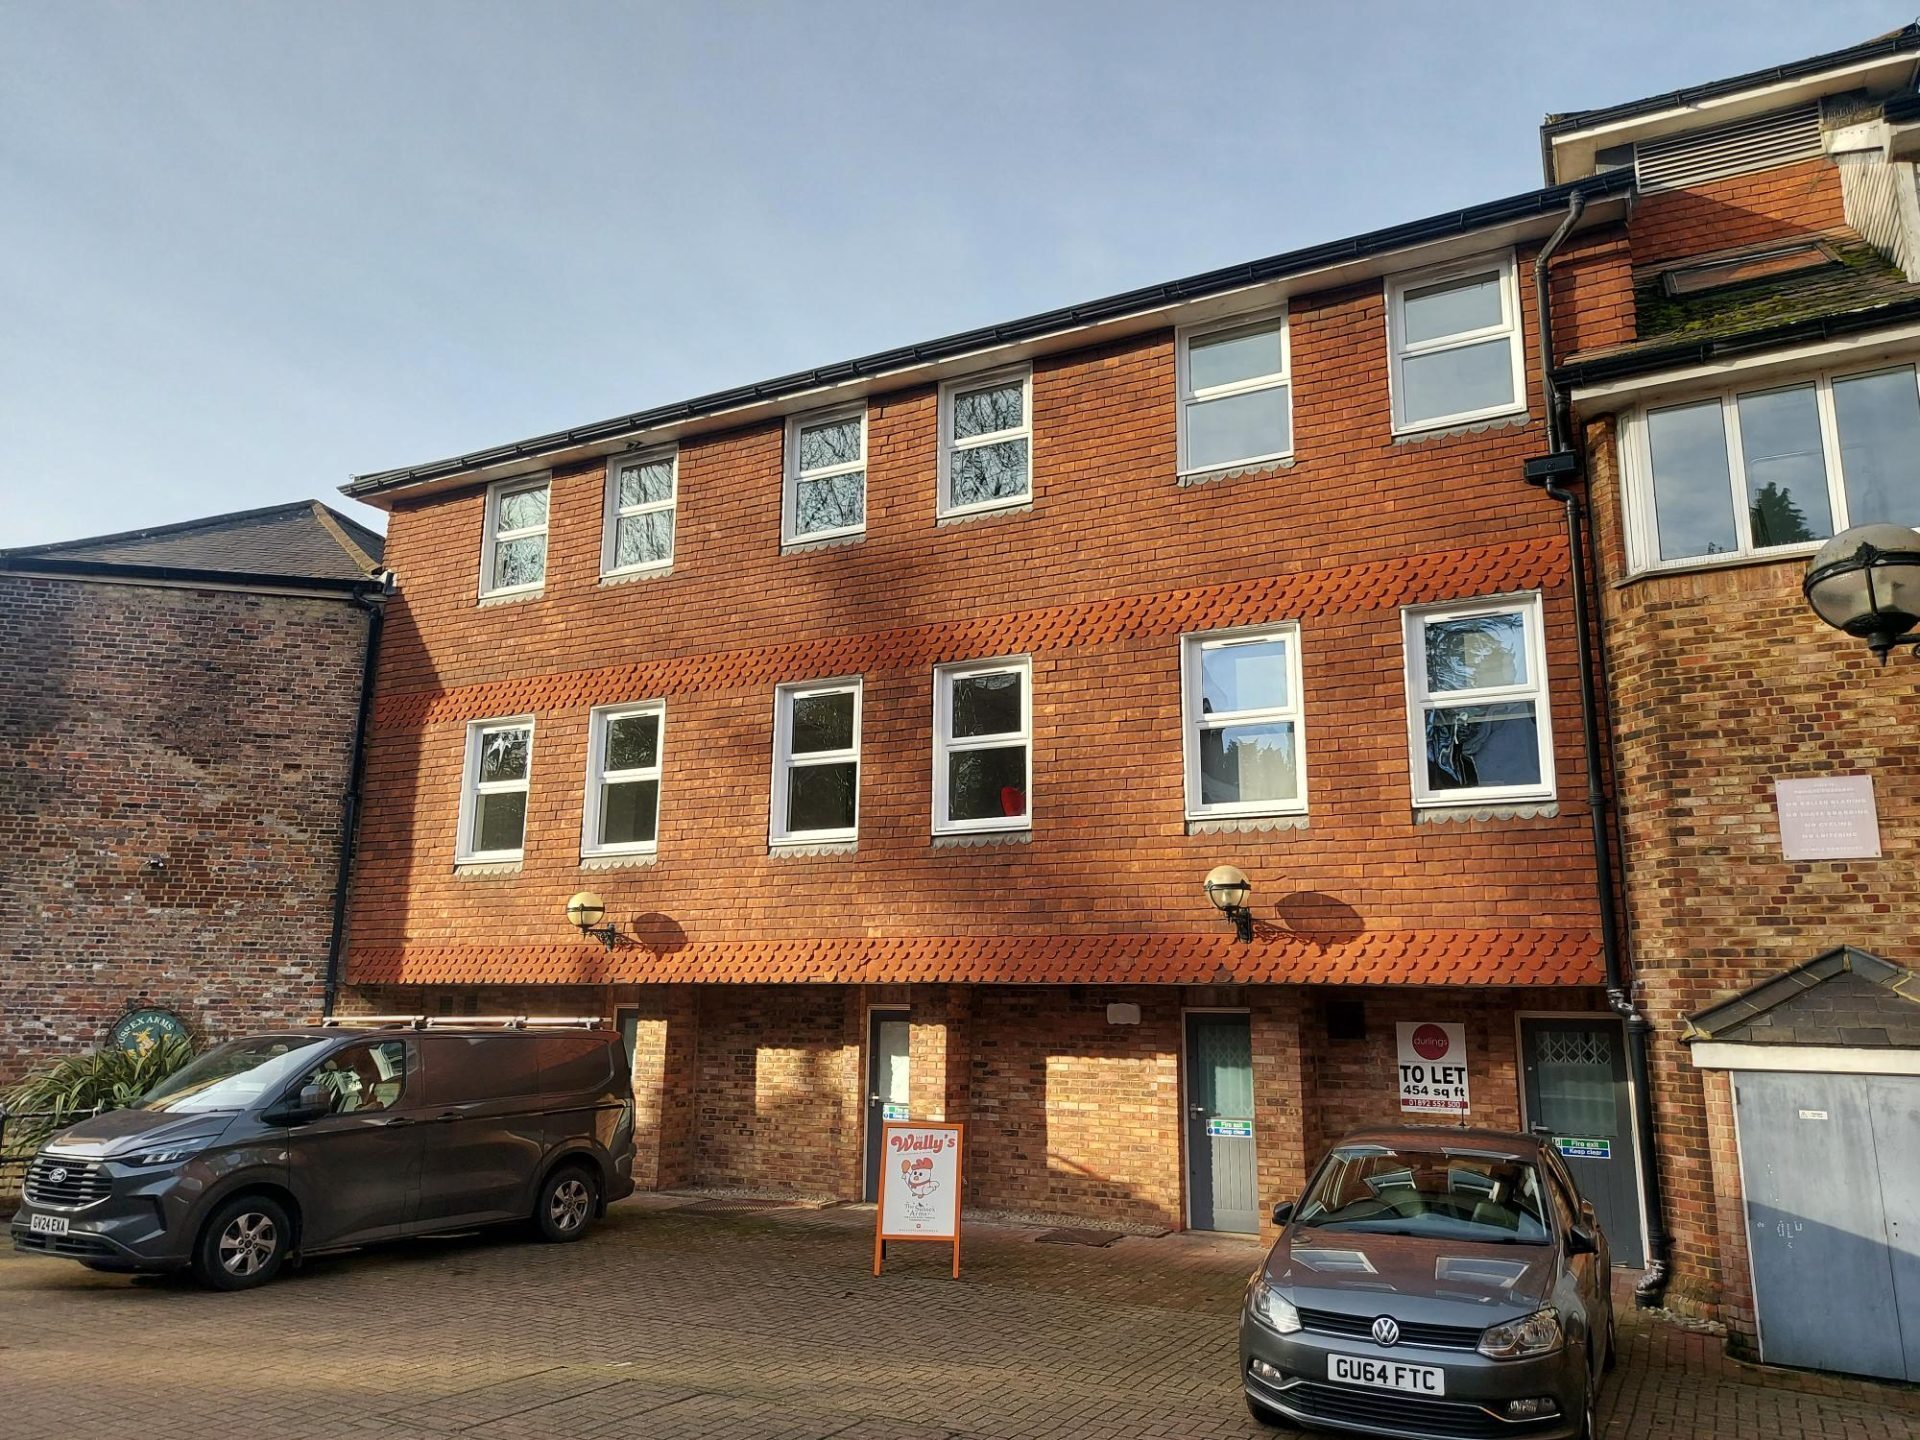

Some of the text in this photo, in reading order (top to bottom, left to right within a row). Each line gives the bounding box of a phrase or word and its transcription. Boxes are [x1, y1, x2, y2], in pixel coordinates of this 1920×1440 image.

[146, 1016, 174, 1031] ARMS
[1413, 1037, 1448, 1047] durlings
[1400, 1065, 1466, 1085] TO LET
[1403, 1085, 1465, 1098] 454 sq ft
[1408, 1099, 1431, 1107] 01892
[890, 1133, 956, 1154] Wally's
[1336, 1358, 1435, 1391] GU64 FTC
